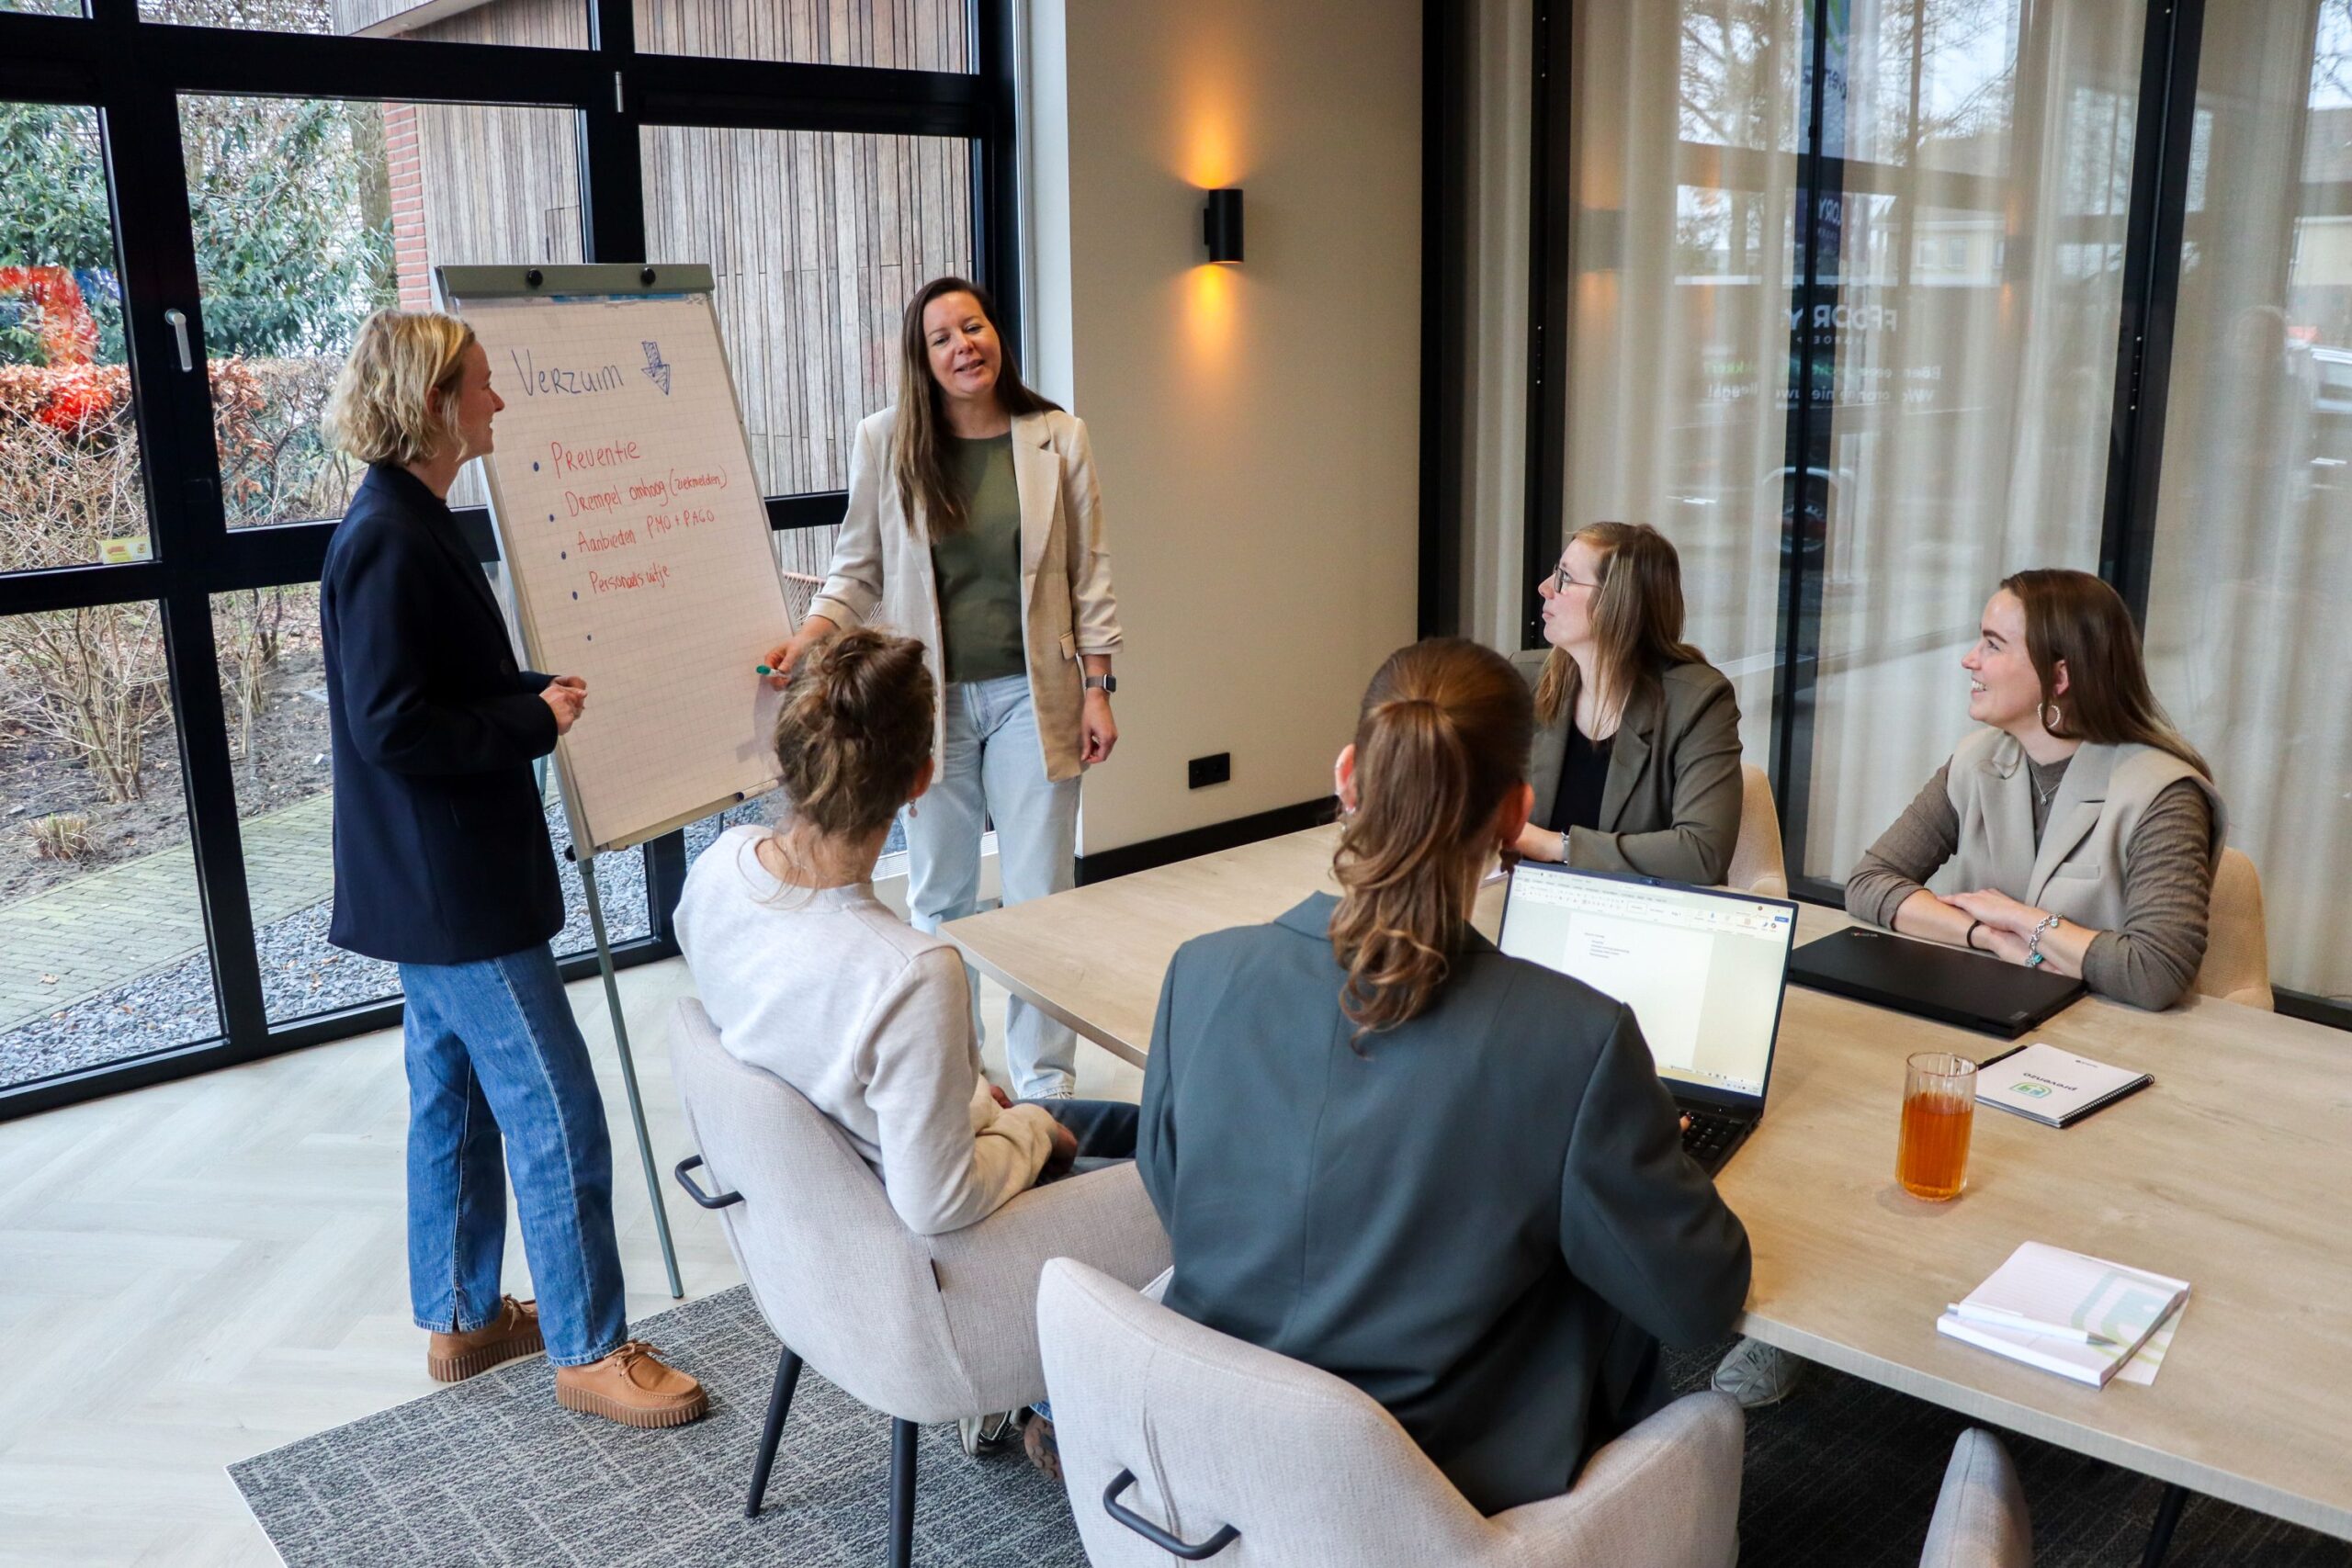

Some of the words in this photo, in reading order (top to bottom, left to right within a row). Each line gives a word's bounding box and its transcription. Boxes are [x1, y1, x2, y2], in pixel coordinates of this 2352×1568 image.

[511, 348, 625, 397] Verzuim
[550, 439, 641, 479] Preventie
[565, 485, 623, 517] Drempel
[628, 477, 668, 507] omhoog
[577, 528, 637, 553] Aanbieden
[646, 513, 673, 539] PMO
